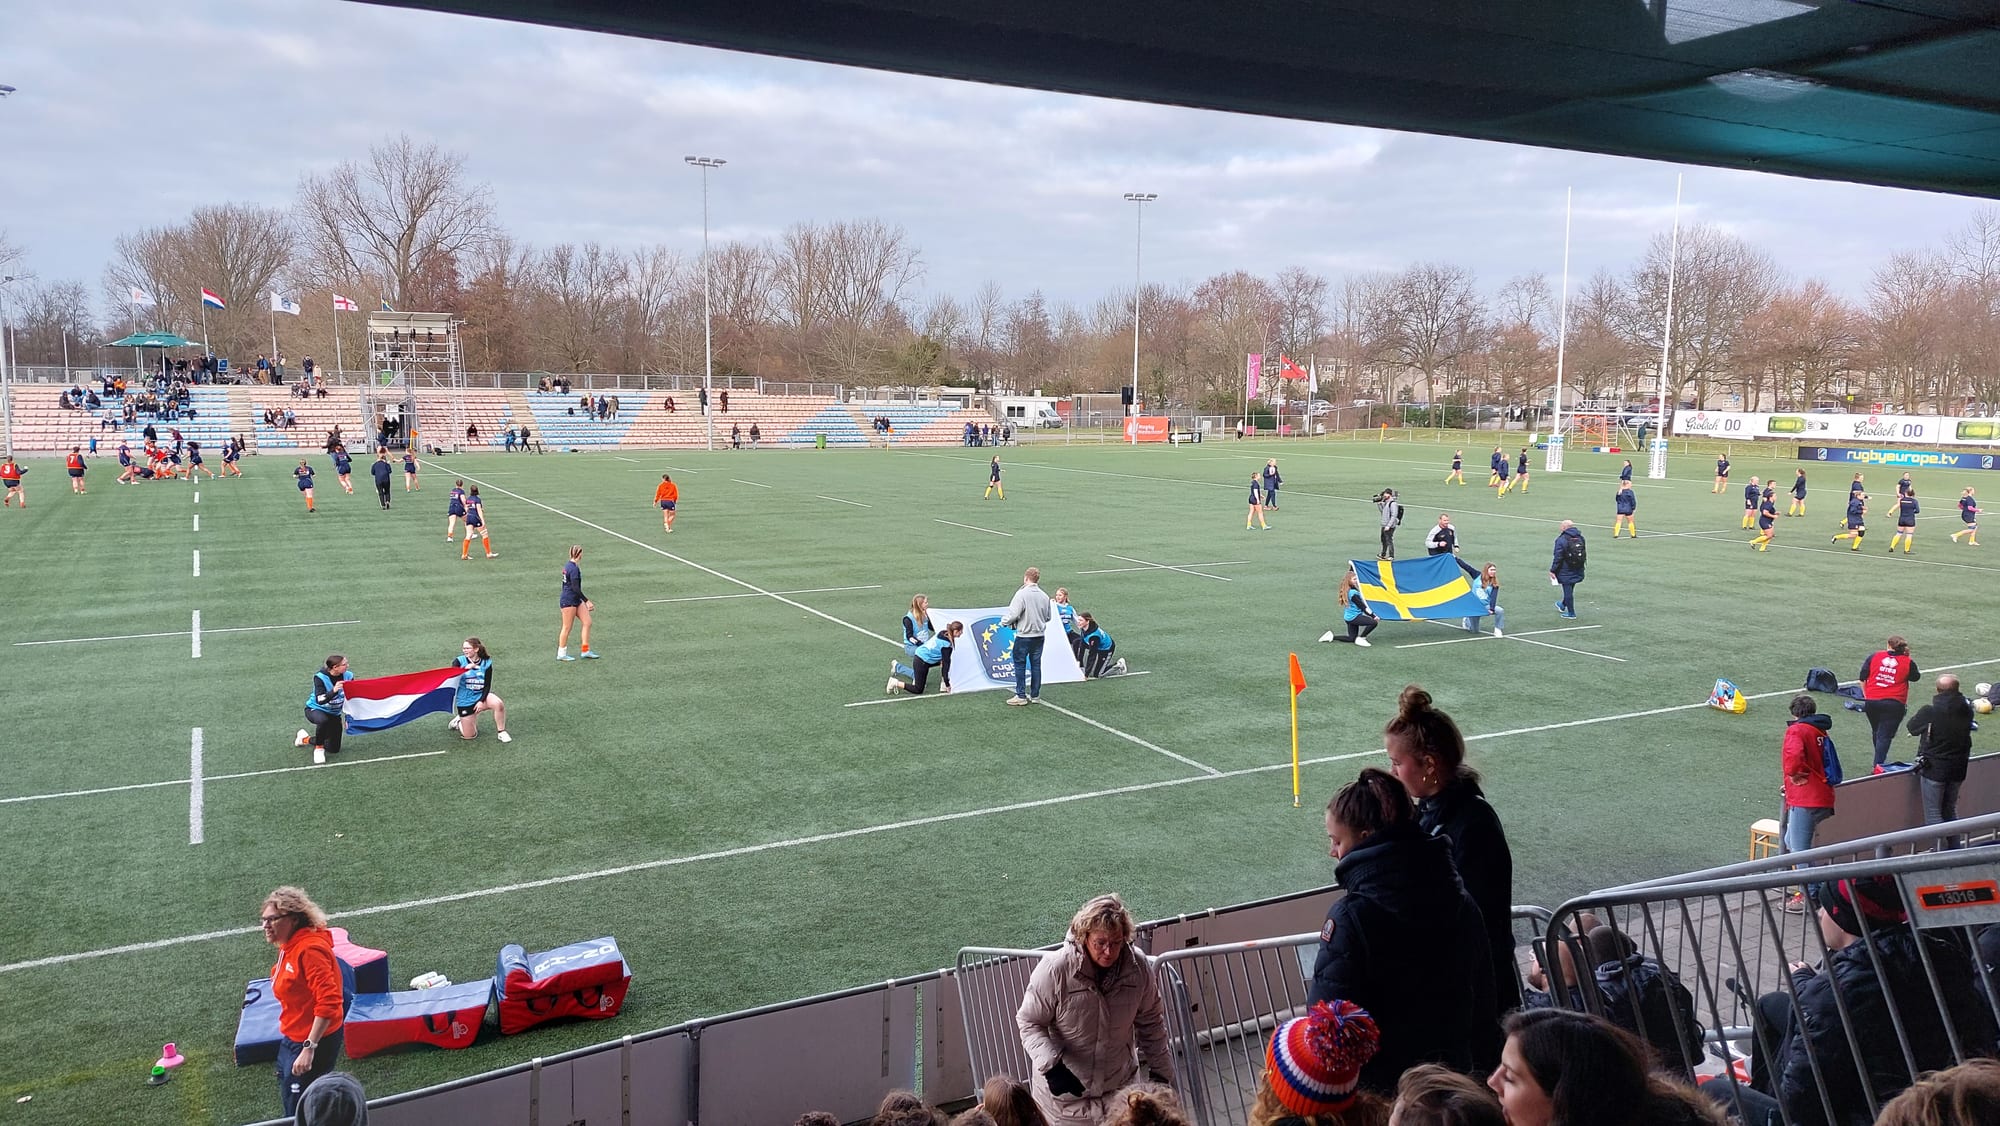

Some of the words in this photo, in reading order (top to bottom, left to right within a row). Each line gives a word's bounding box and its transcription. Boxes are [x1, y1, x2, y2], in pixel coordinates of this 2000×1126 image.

[1686, 417, 1718, 431] Grolsch
[1853, 421, 1897, 438] Grolsch
[69, 455, 75, 464] 7
[1846, 449, 1959, 466] rugbyeurope.tv
[534, 945, 616, 974] RHINO
